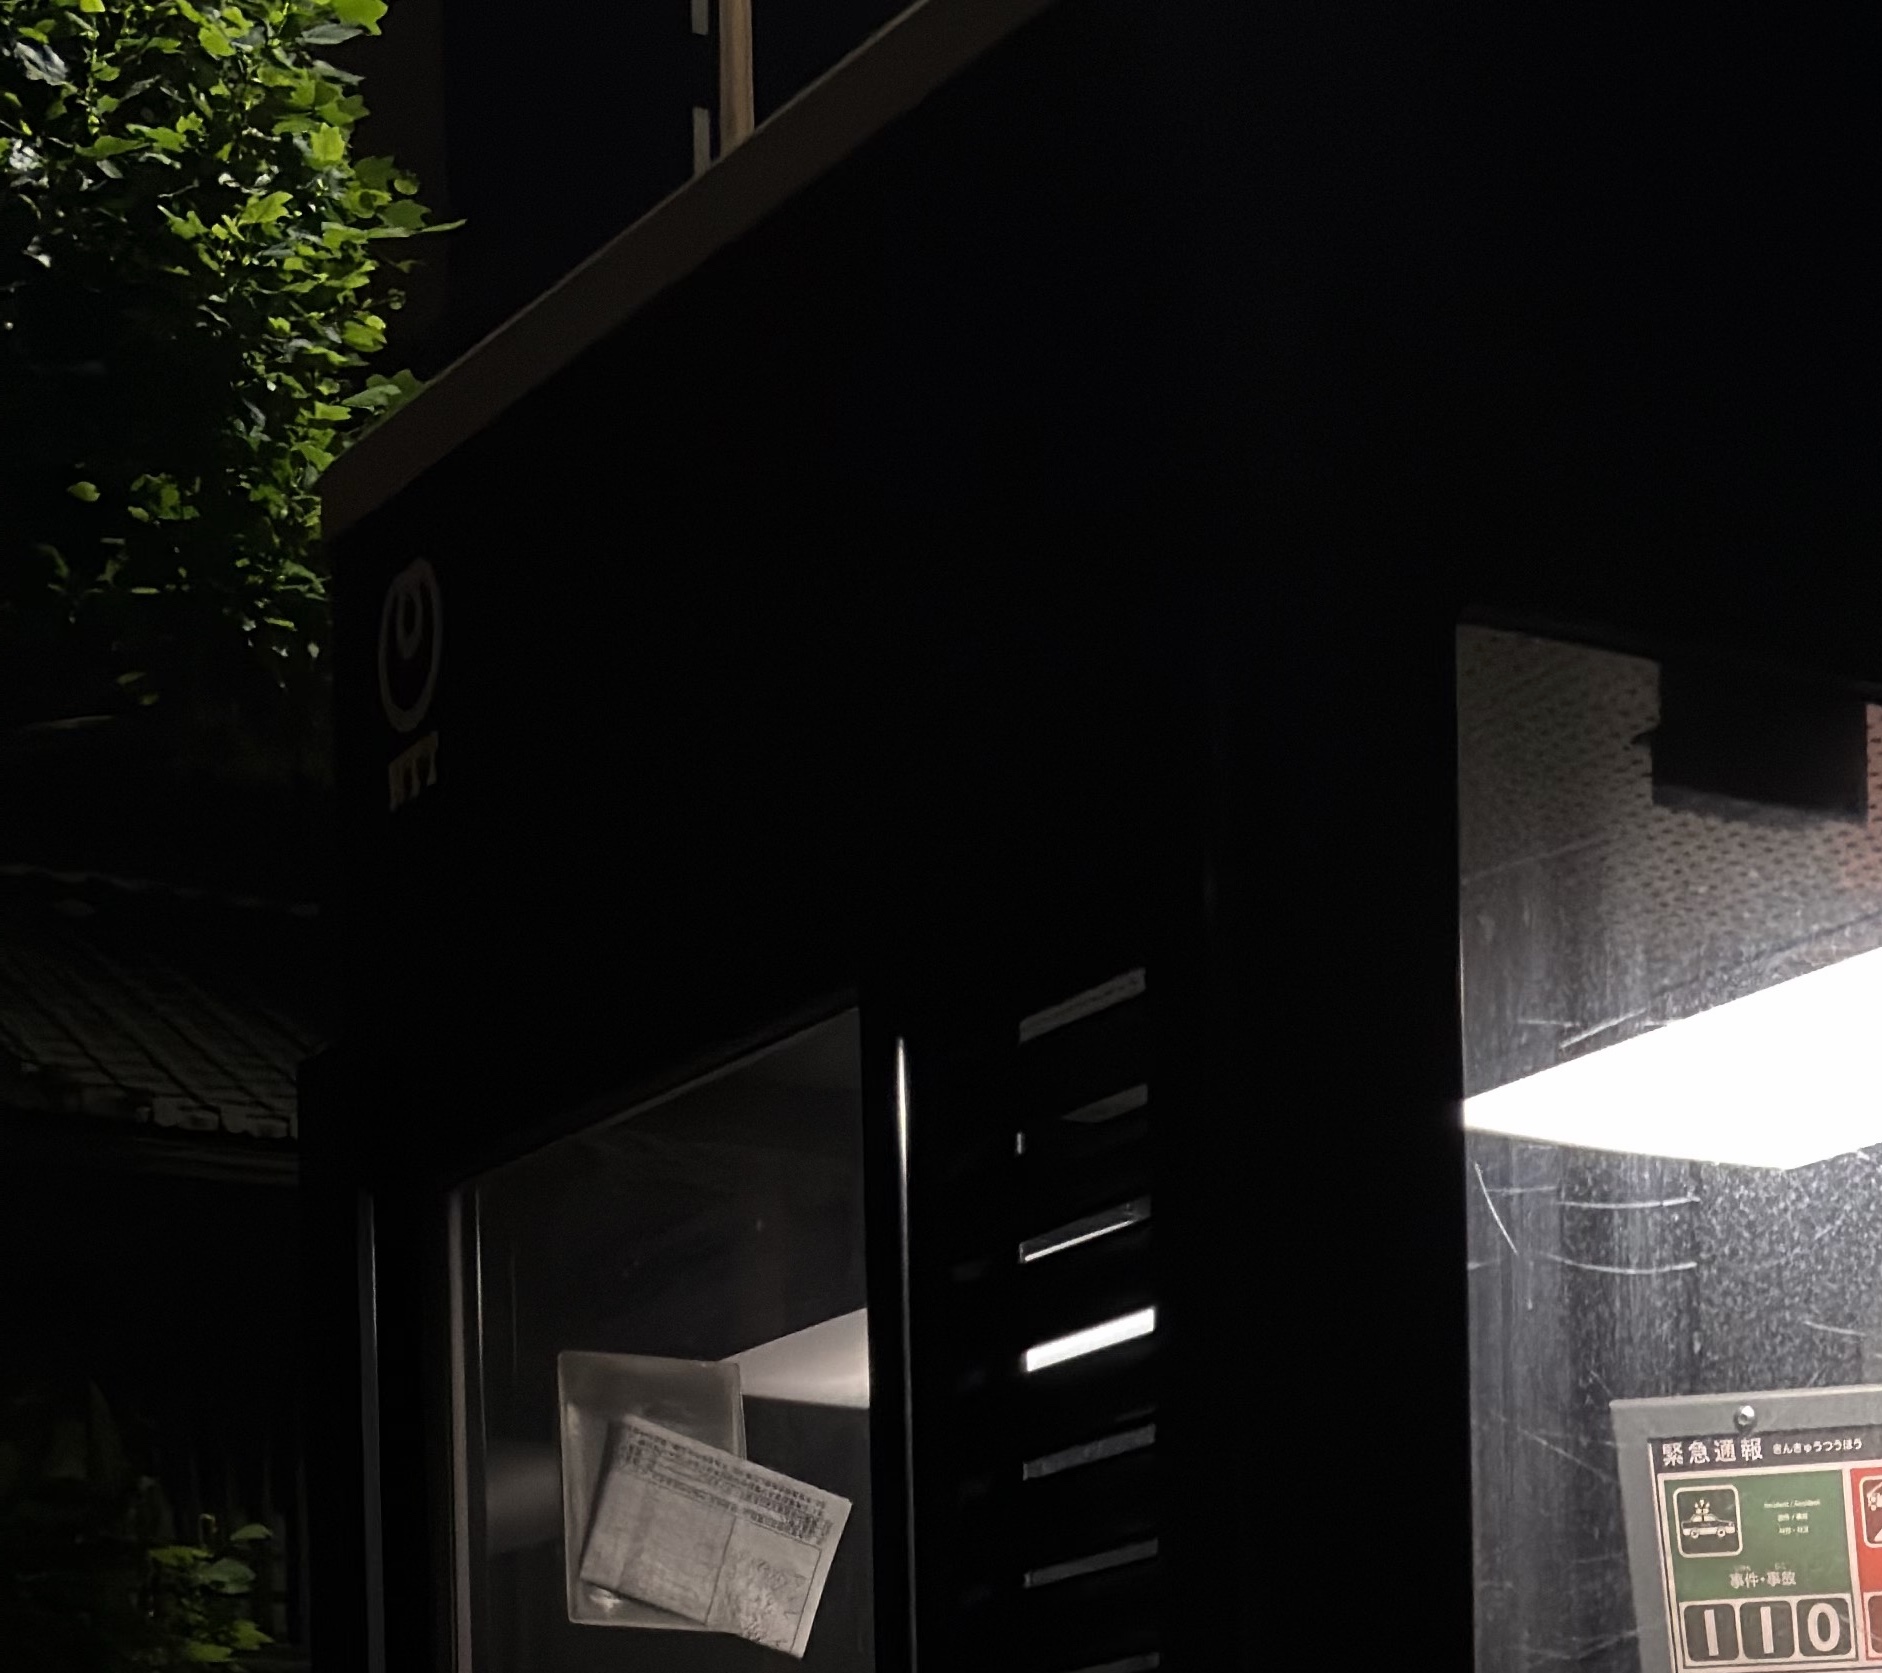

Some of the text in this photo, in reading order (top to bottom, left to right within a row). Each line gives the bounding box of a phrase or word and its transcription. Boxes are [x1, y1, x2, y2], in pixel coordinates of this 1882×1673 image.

[1662, 1438, 1862, 1467] 緊急通報 きんきゅうつうほう
[1704, 1602, 1841, 1657] 110
